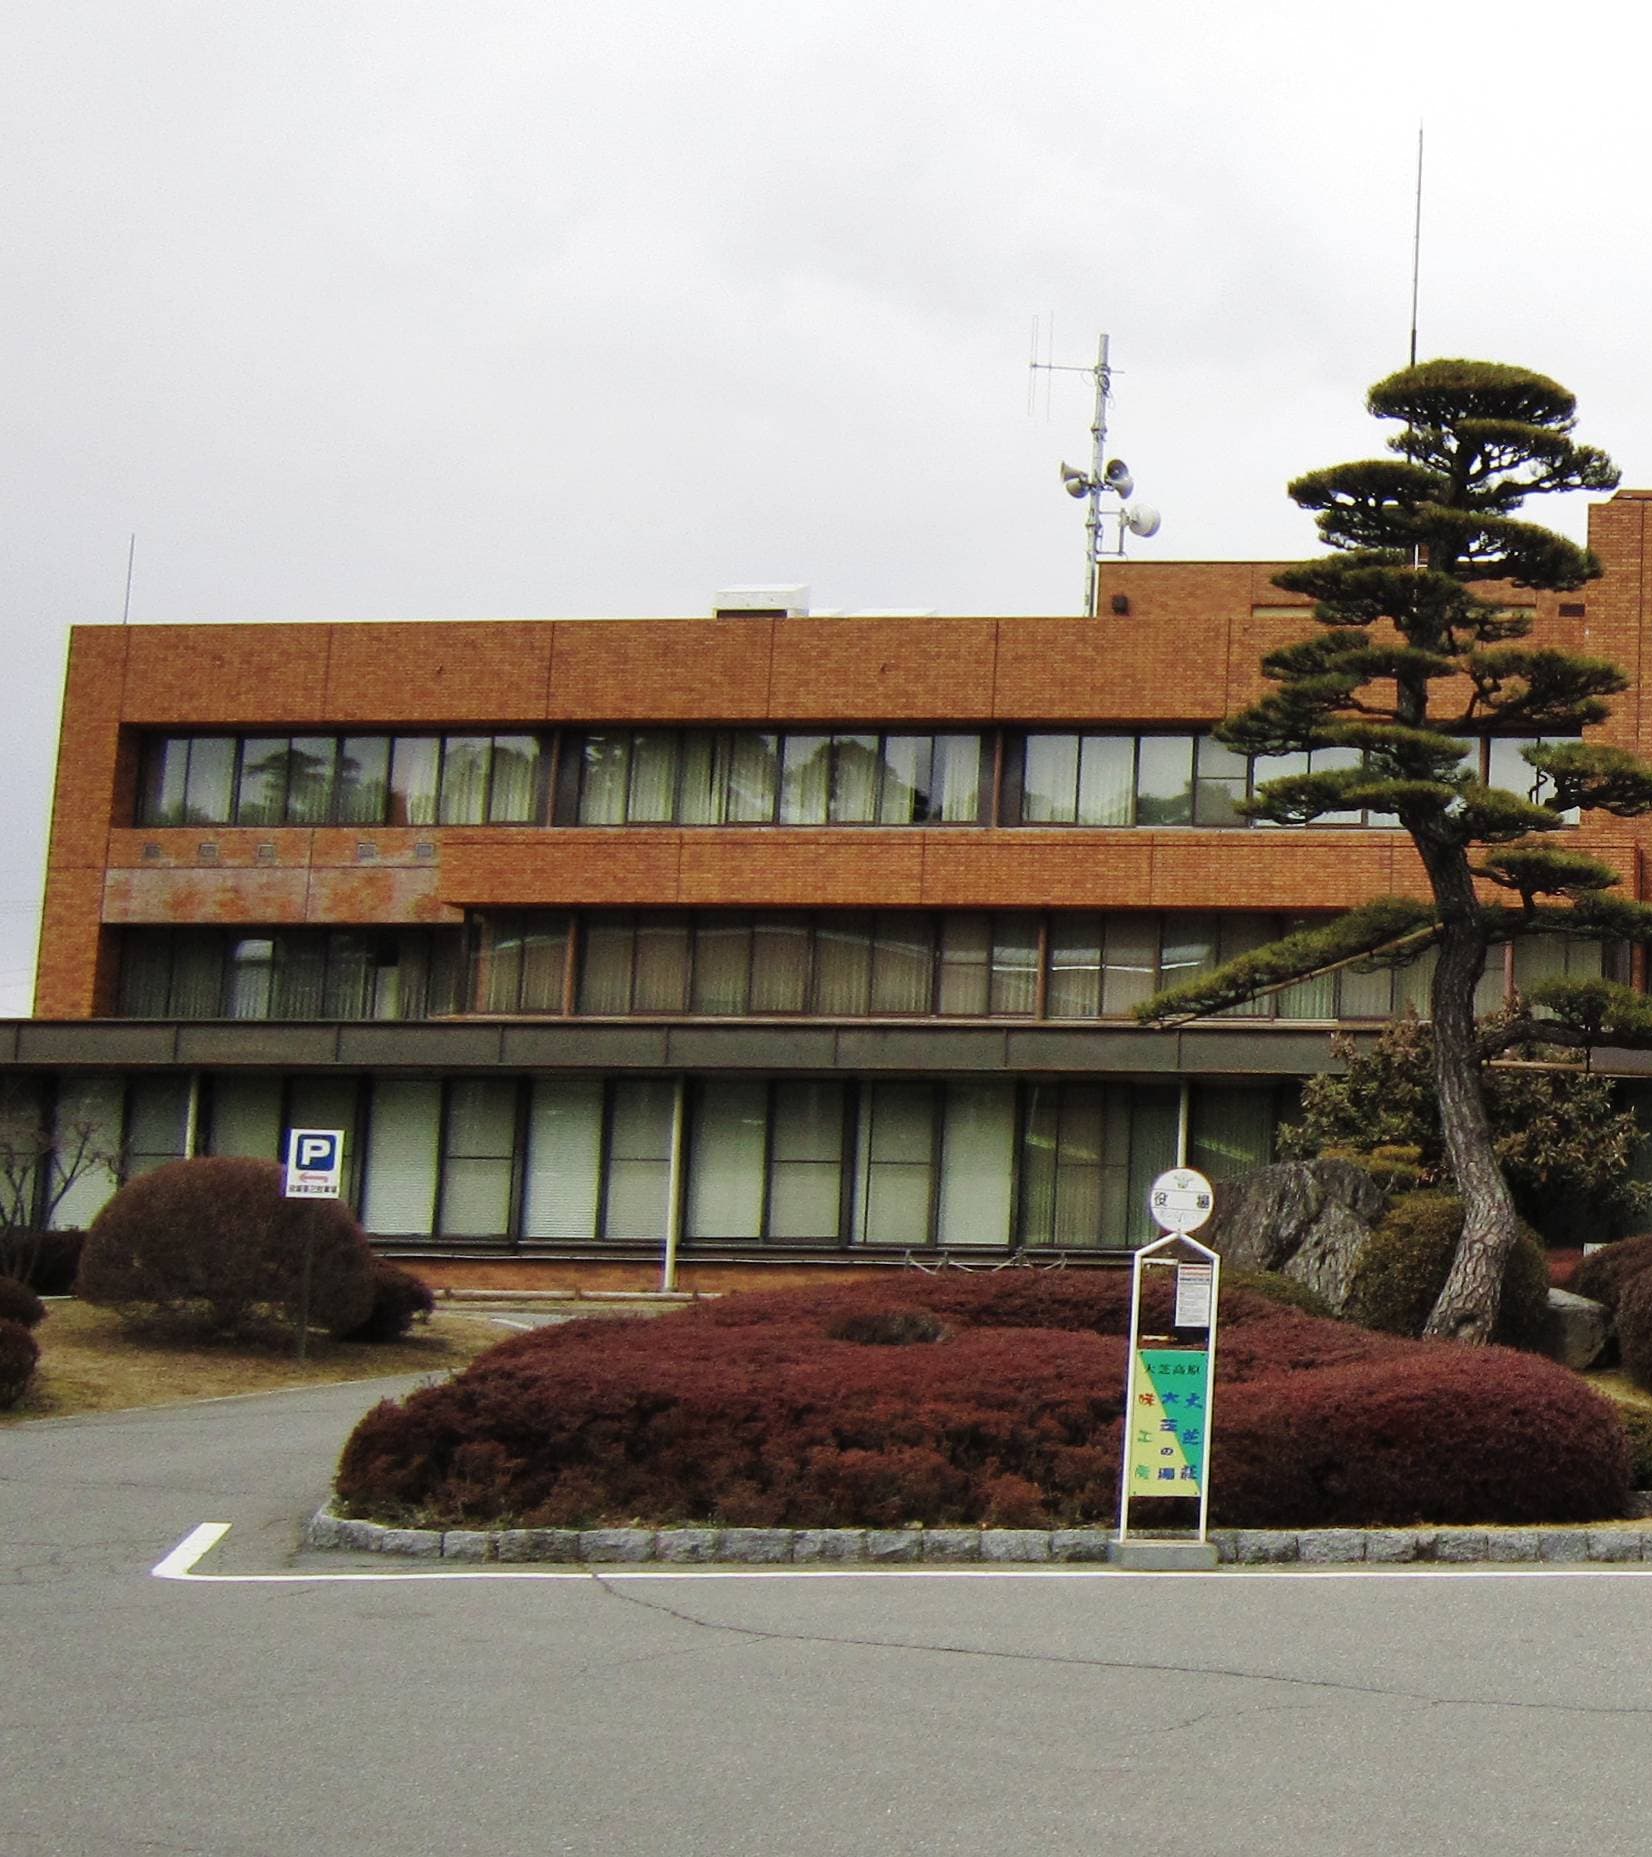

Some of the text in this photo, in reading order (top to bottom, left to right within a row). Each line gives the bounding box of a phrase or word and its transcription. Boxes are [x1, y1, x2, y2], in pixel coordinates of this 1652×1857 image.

[300, 1138, 331, 1166] P
[1145, 1363, 1200, 1375] 大芝高原
